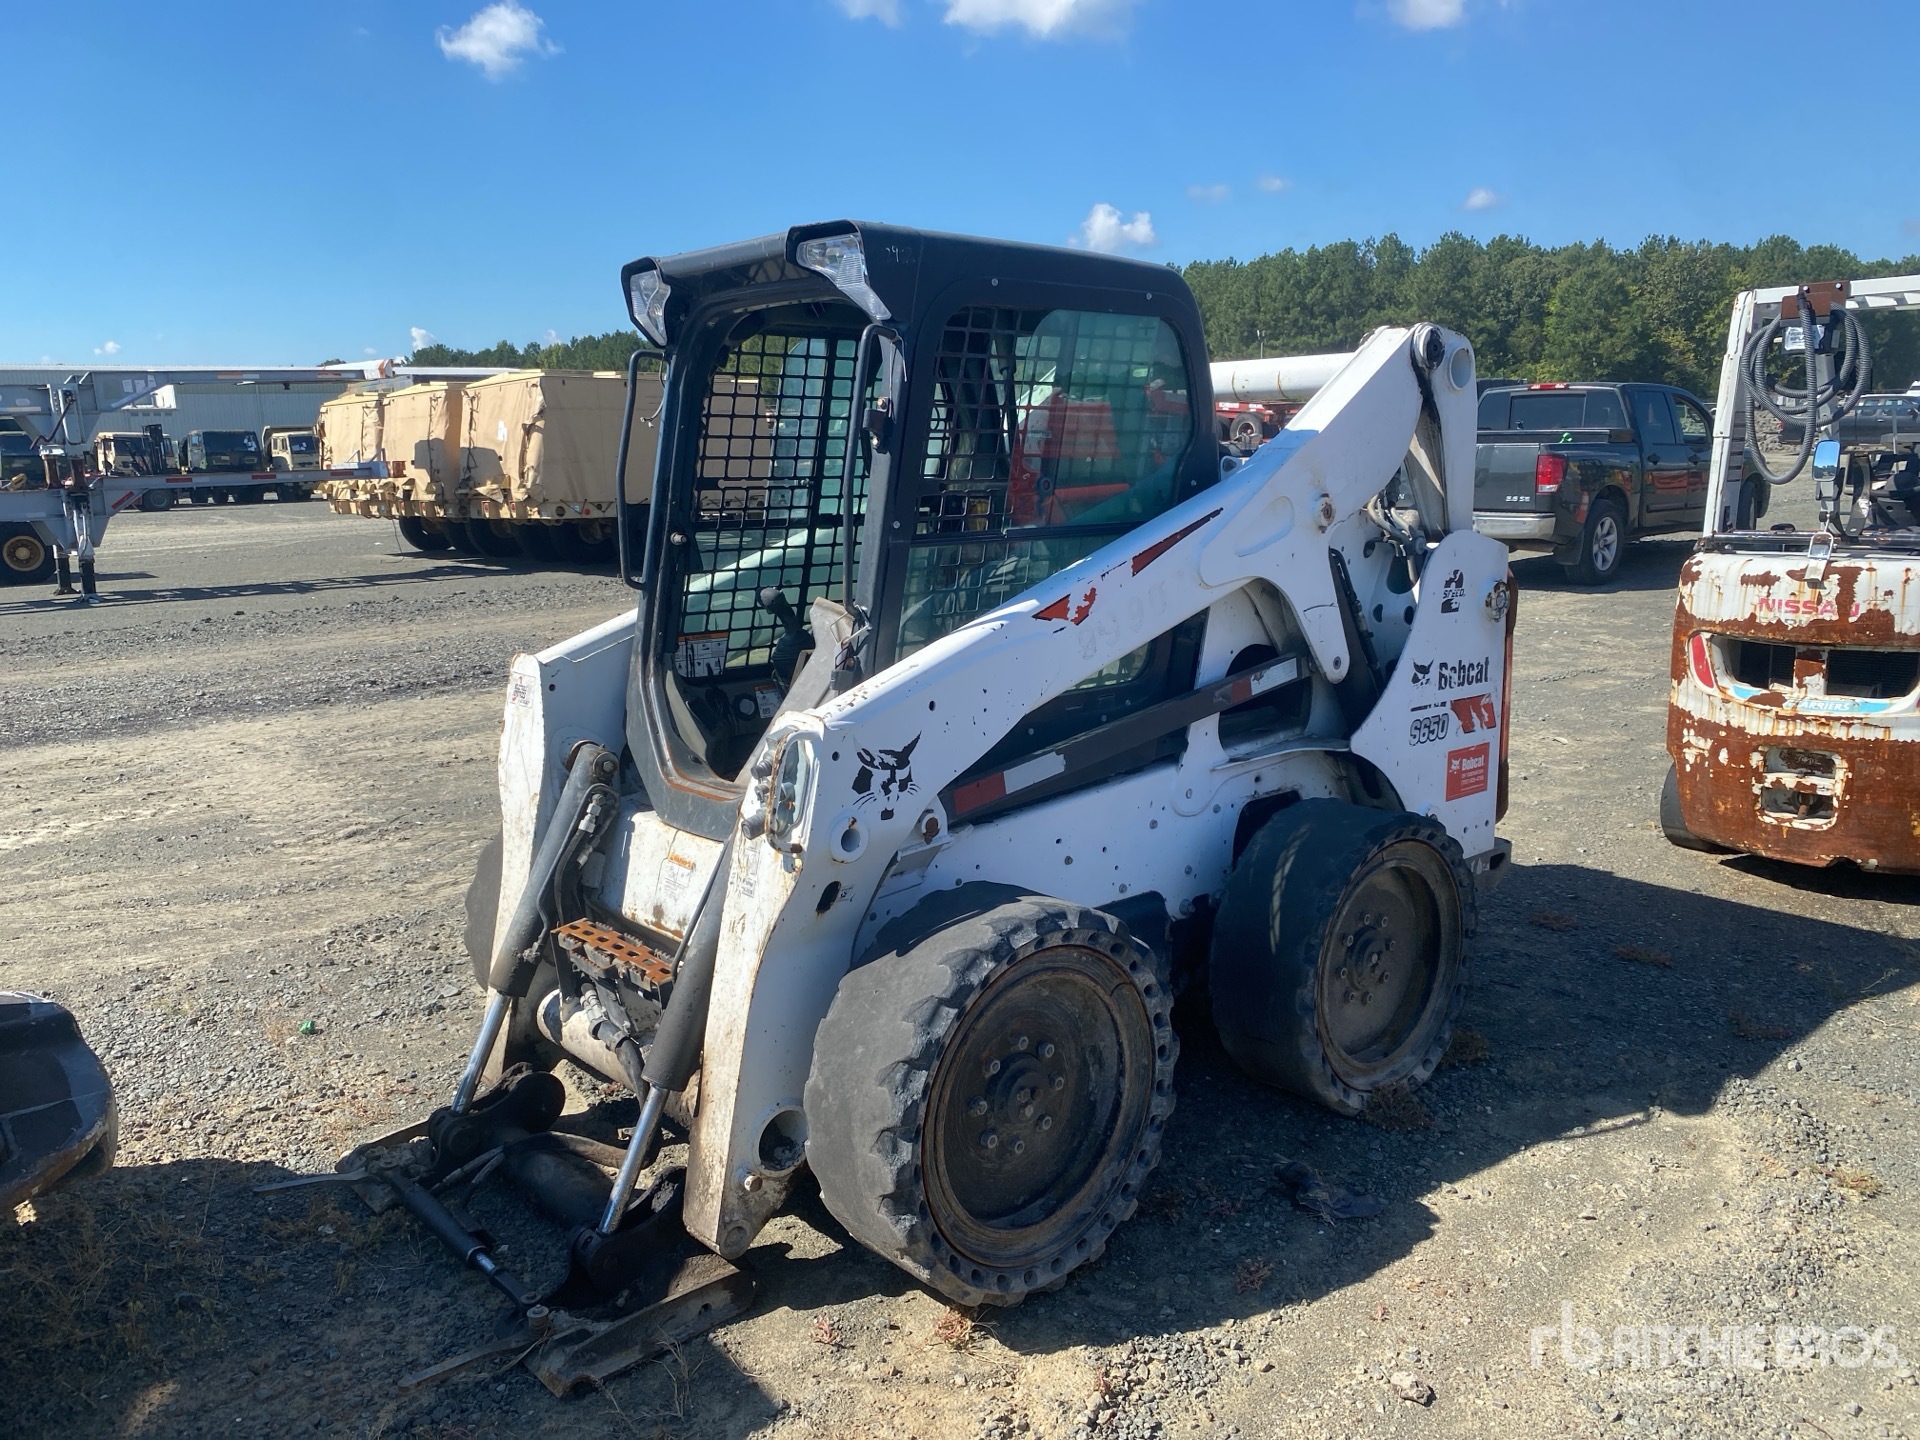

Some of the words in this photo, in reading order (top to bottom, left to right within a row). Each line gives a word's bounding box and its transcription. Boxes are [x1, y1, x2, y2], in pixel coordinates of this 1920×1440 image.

[1438, 656, 1490, 691] Bobcat
[1409, 712, 1450, 747] S650
[1461, 754, 1485, 771] Bobcat
